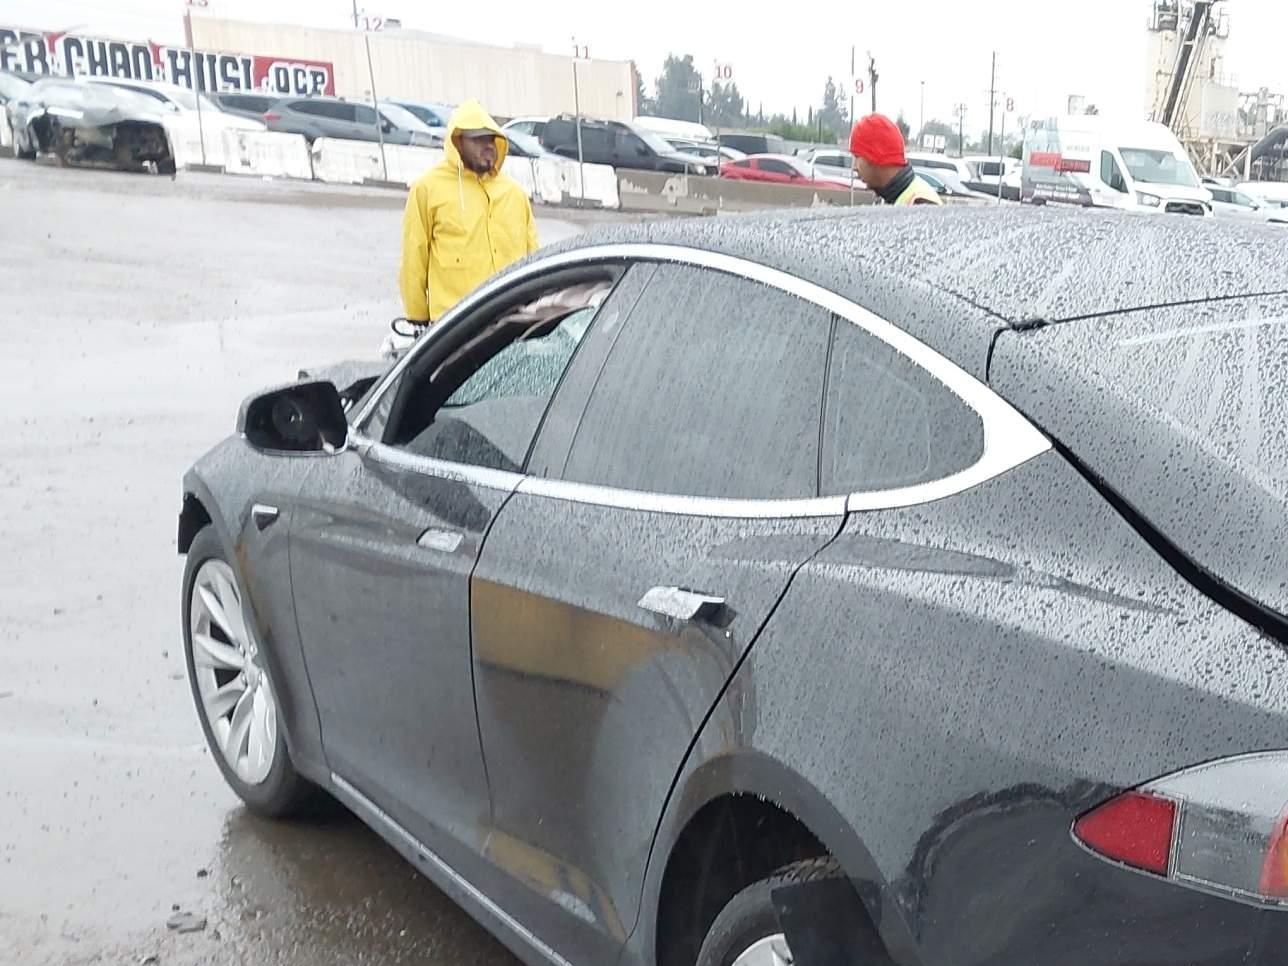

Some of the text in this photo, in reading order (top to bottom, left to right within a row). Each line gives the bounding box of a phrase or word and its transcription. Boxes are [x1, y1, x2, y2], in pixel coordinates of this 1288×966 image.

[363, 16, 384, 32] 12
[716, 65, 733, 80] 10
[855, 78, 865, 95] 9
[1006, 97, 1015, 112] 8
